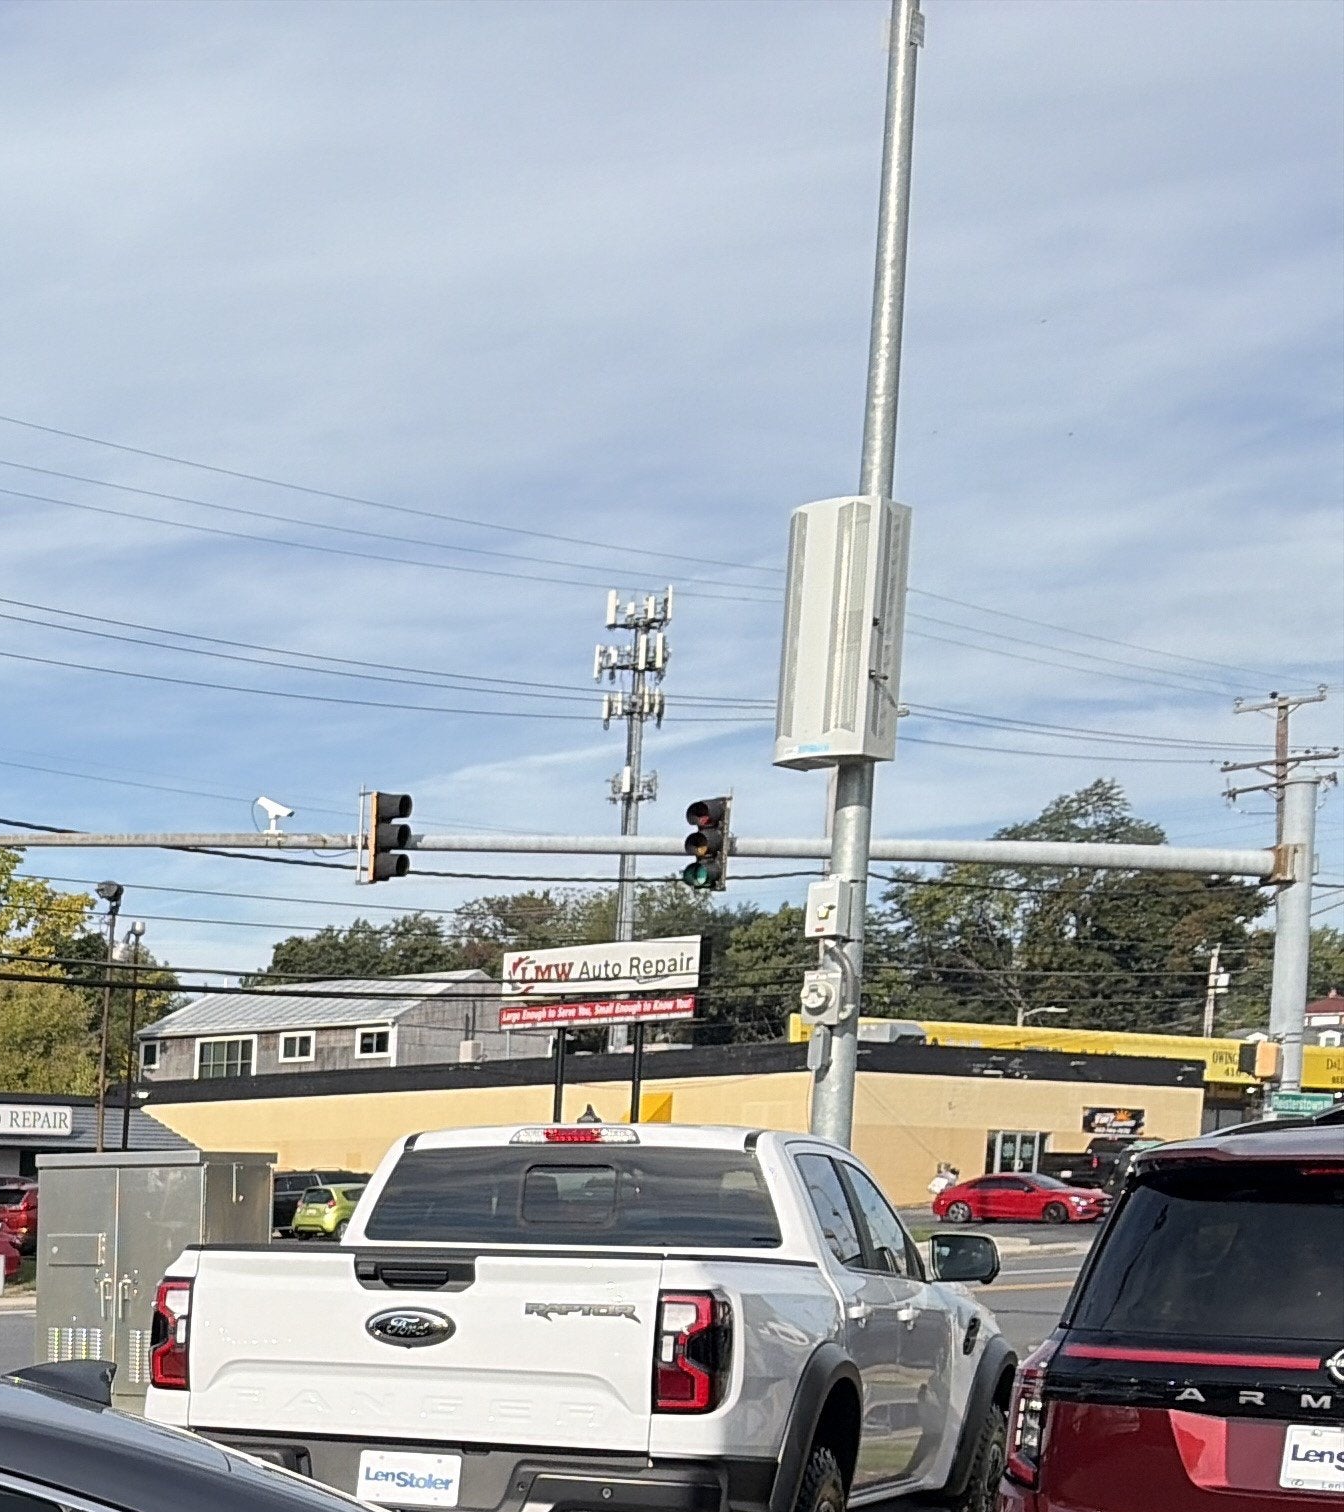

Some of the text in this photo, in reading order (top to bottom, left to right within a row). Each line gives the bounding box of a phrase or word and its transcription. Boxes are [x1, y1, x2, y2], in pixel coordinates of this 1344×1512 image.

[520, 952, 694, 981] LMW Auto Repair
[502, 1010, 521, 1023] Large
[9, 1110, 69, 1129] REPAIR
[524, 1302, 642, 1325] RAPTOR
